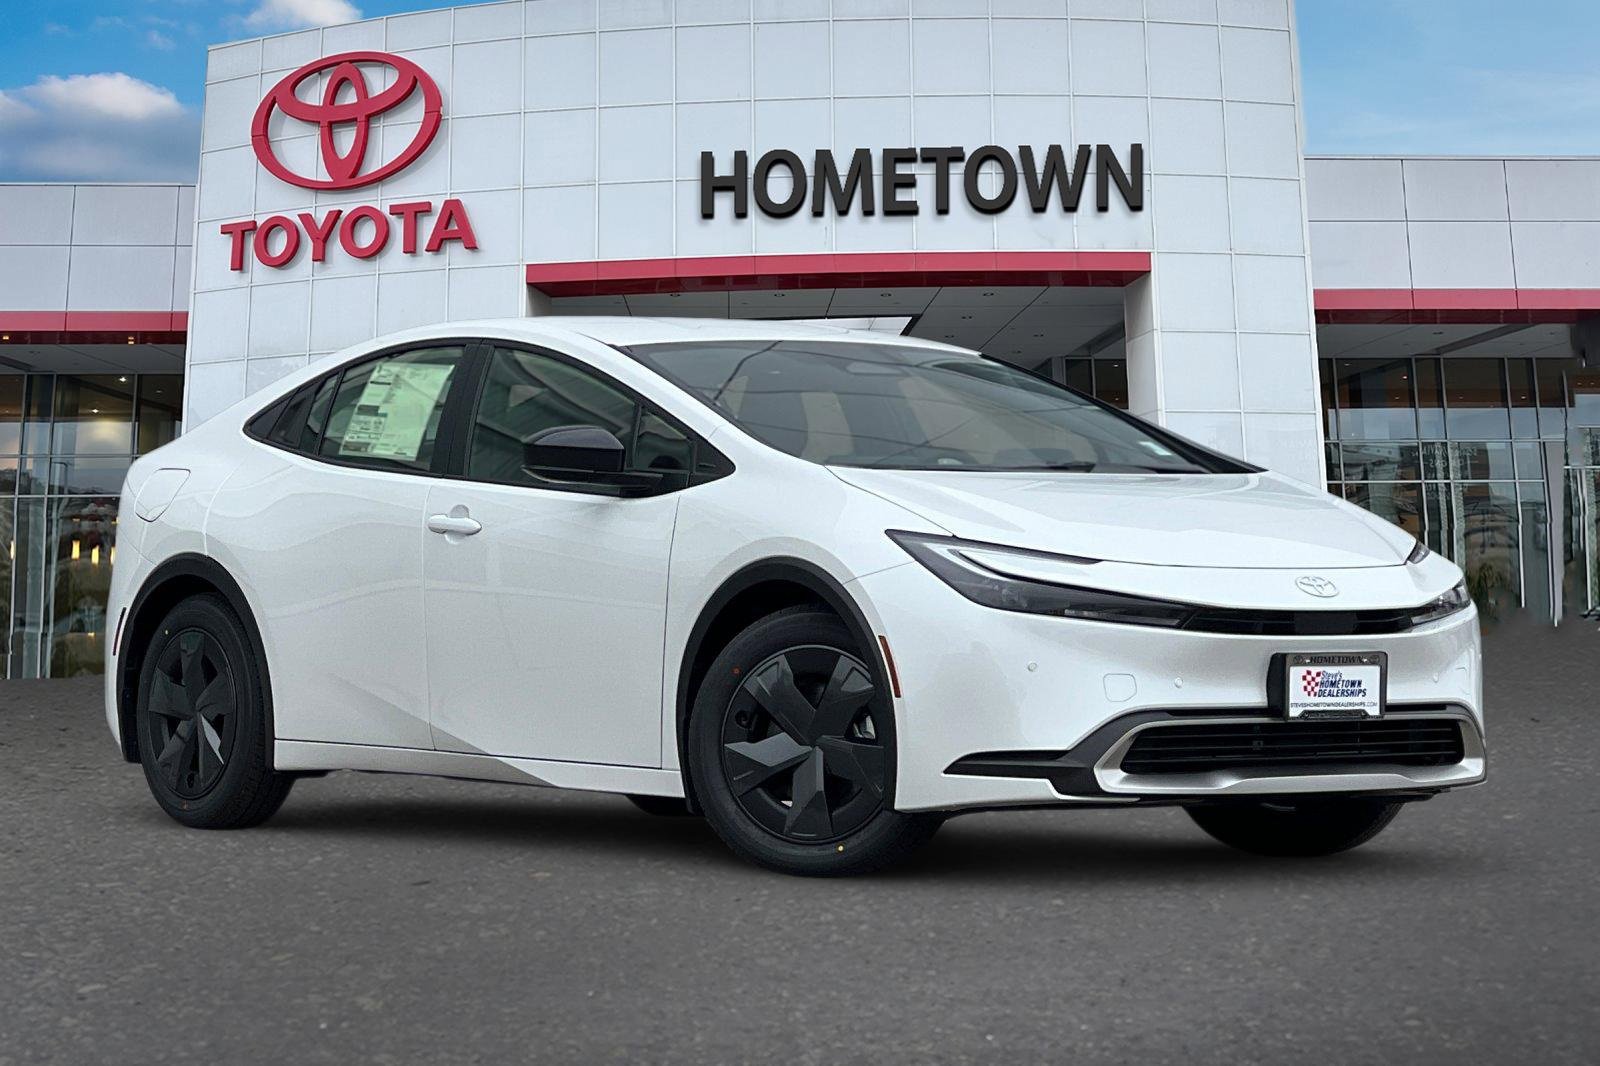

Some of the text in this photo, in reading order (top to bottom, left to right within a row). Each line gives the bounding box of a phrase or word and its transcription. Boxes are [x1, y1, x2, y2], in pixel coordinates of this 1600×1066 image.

[700, 143, 1144, 219] HOMETOWN
[220, 199, 479, 271] TOYOTA
[1310, 656, 1363, 664] HOMETOWN
[1321, 670, 1343, 679] Steve's
[1320, 680, 1362, 688] HOMETOWN
[1318, 689, 1367, 697] DEALERSHIPS
